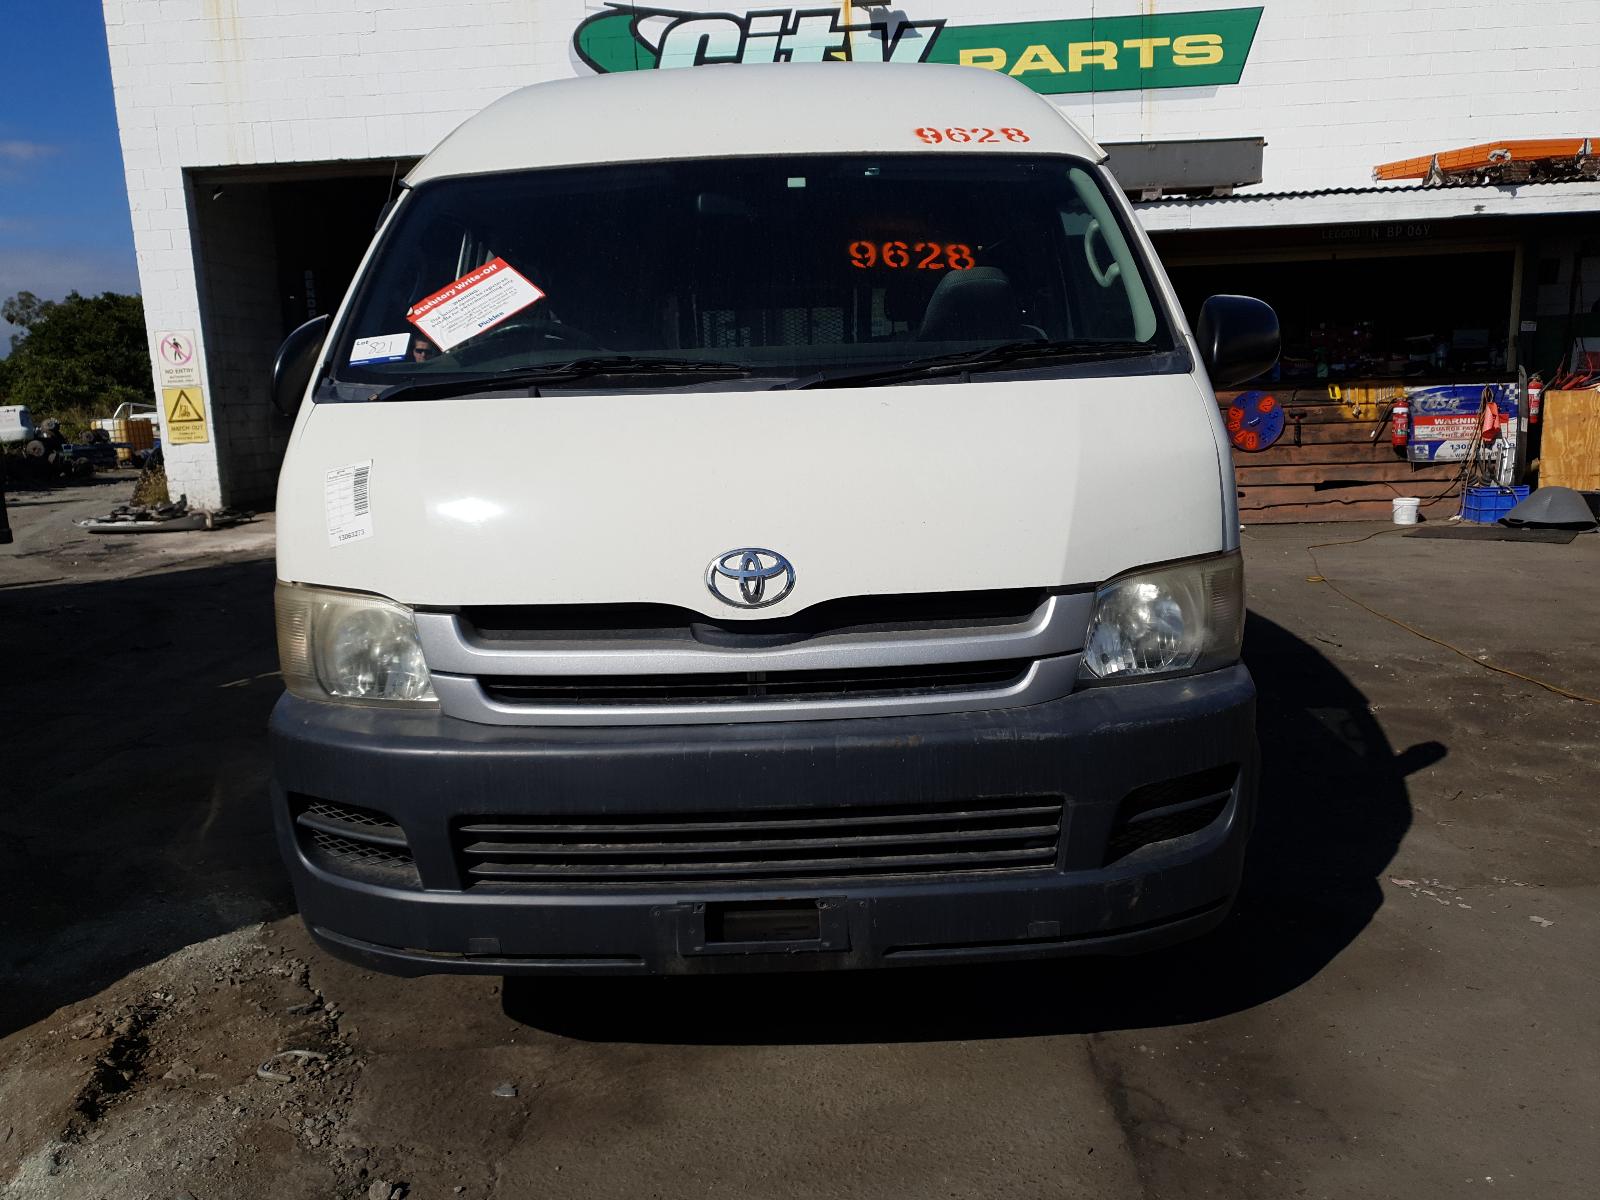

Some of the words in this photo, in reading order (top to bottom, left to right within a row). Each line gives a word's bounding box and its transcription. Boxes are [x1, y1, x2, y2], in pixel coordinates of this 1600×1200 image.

[959, 33, 1224, 76] PARTS
[912, 127, 1031, 144] 9628
[849, 241, 976, 270] 9628
[413, 288, 456, 315] Statutory
[454, 263, 498, 291] Write-Off
[1434, 416, 1478, 425] WARNIN
